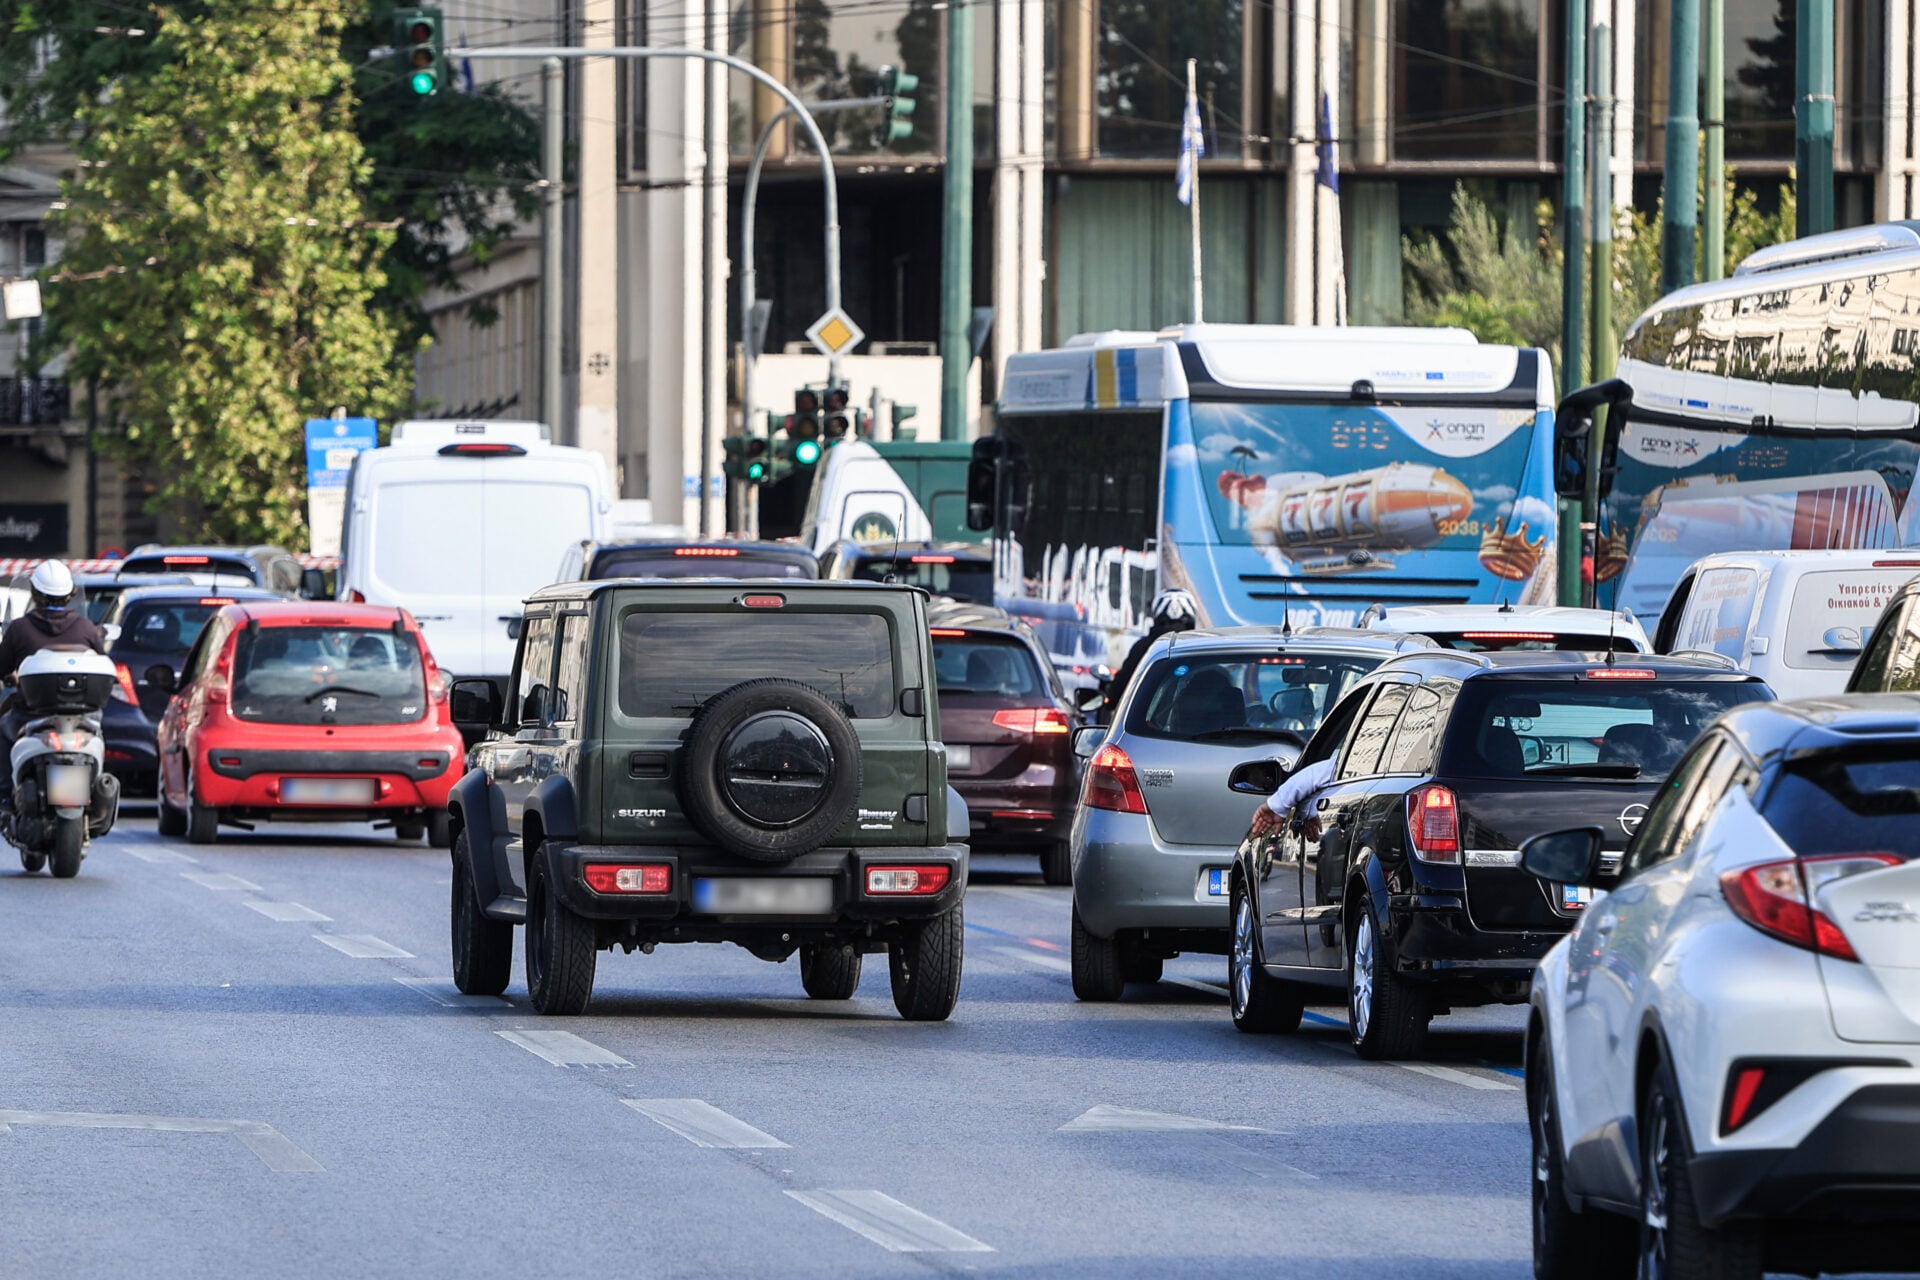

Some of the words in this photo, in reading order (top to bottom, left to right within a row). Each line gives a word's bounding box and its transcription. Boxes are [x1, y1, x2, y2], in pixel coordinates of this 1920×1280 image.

[1439, 520, 1479, 536] 2038
[1838, 582, 1893, 596] Υπηρεσίες
[1828, 596, 1870, 609] Οικιακού
[1873, 597, 1882, 608] &
[1143, 768, 1175, 776] TOYOTA
[618, 809, 666, 817] SUZUKI
[1471, 853, 1509, 864] ASTRA
[1210, 883, 1221, 891] GR
[1566, 889, 1578, 899] GR
